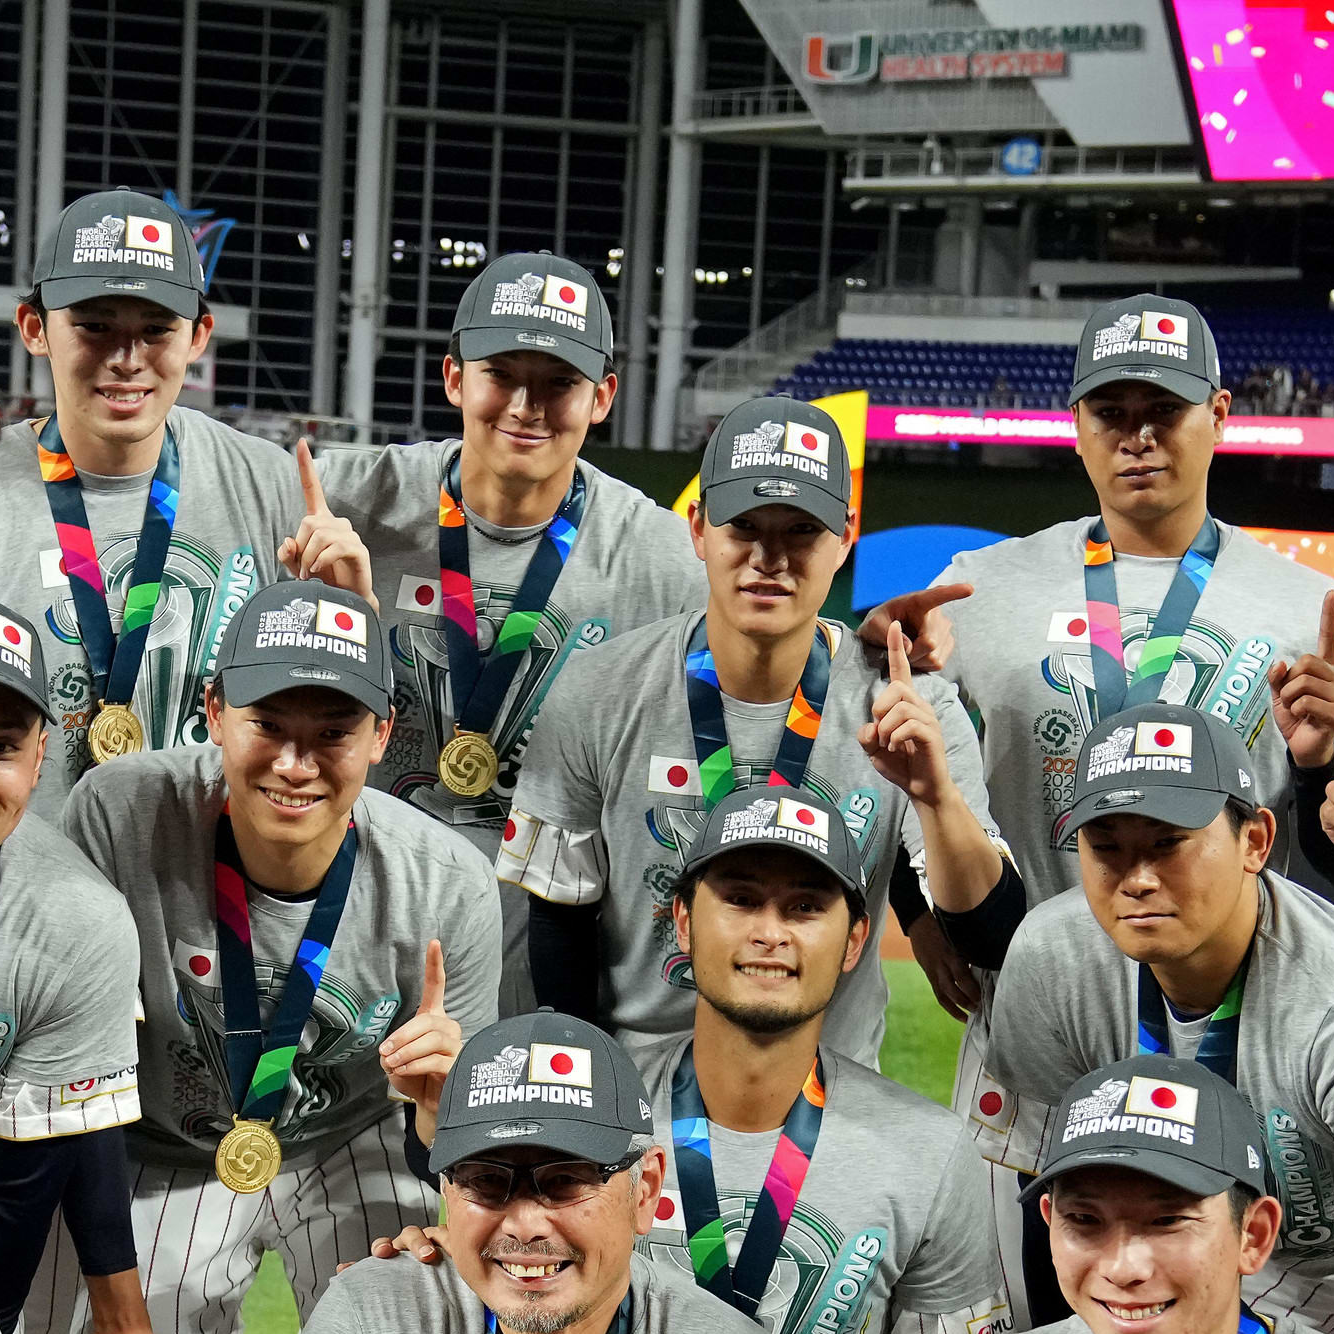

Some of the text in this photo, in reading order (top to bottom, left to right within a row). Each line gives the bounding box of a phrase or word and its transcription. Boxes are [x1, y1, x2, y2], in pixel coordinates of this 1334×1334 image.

[881, 51, 1066, 81] HEALTH SYSTEM
[1005, 143, 1038, 170] 42
[73, 248, 173, 271] CHAMPIONS
[491, 302, 586, 331] CHAMPIONS
[1093, 342, 1187, 361] CHAMPIONS
[731, 454, 828, 480] CHAMPIONS
[266, 618, 309, 626] BASEBALL
[256, 633, 367, 662] CHAMPIONS
[49, 667, 64, 695] WORLD
[1033, 708, 1080, 756] WORLD BASEBALL CLASSIC
[1042, 757, 1075, 774] 202
[1087, 758, 1191, 782] CHAMPIONS
[1043, 774, 1074, 788] 202
[1043, 788, 1074, 803] 202
[721, 829, 828, 854] CHAMPIONS
[478, 1063, 506, 1072] WORLD
[478, 1068, 520, 1080] BASEBALL
[477, 1078, 513, 1088] CLASSIC
[468, 1085, 592, 1108] CHAMPIONS
[1074, 1101, 1117, 1114] BASEBALL
[1075, 1096, 1105, 1107] WORLD
[1073, 1109, 1108, 1122] CLASSIC
[1062, 1116, 1195, 1145] CHAMPIONS
[219, 1133, 234, 1158] WORLD
[1273, 1114, 1331, 1246] CHAMPIONS
